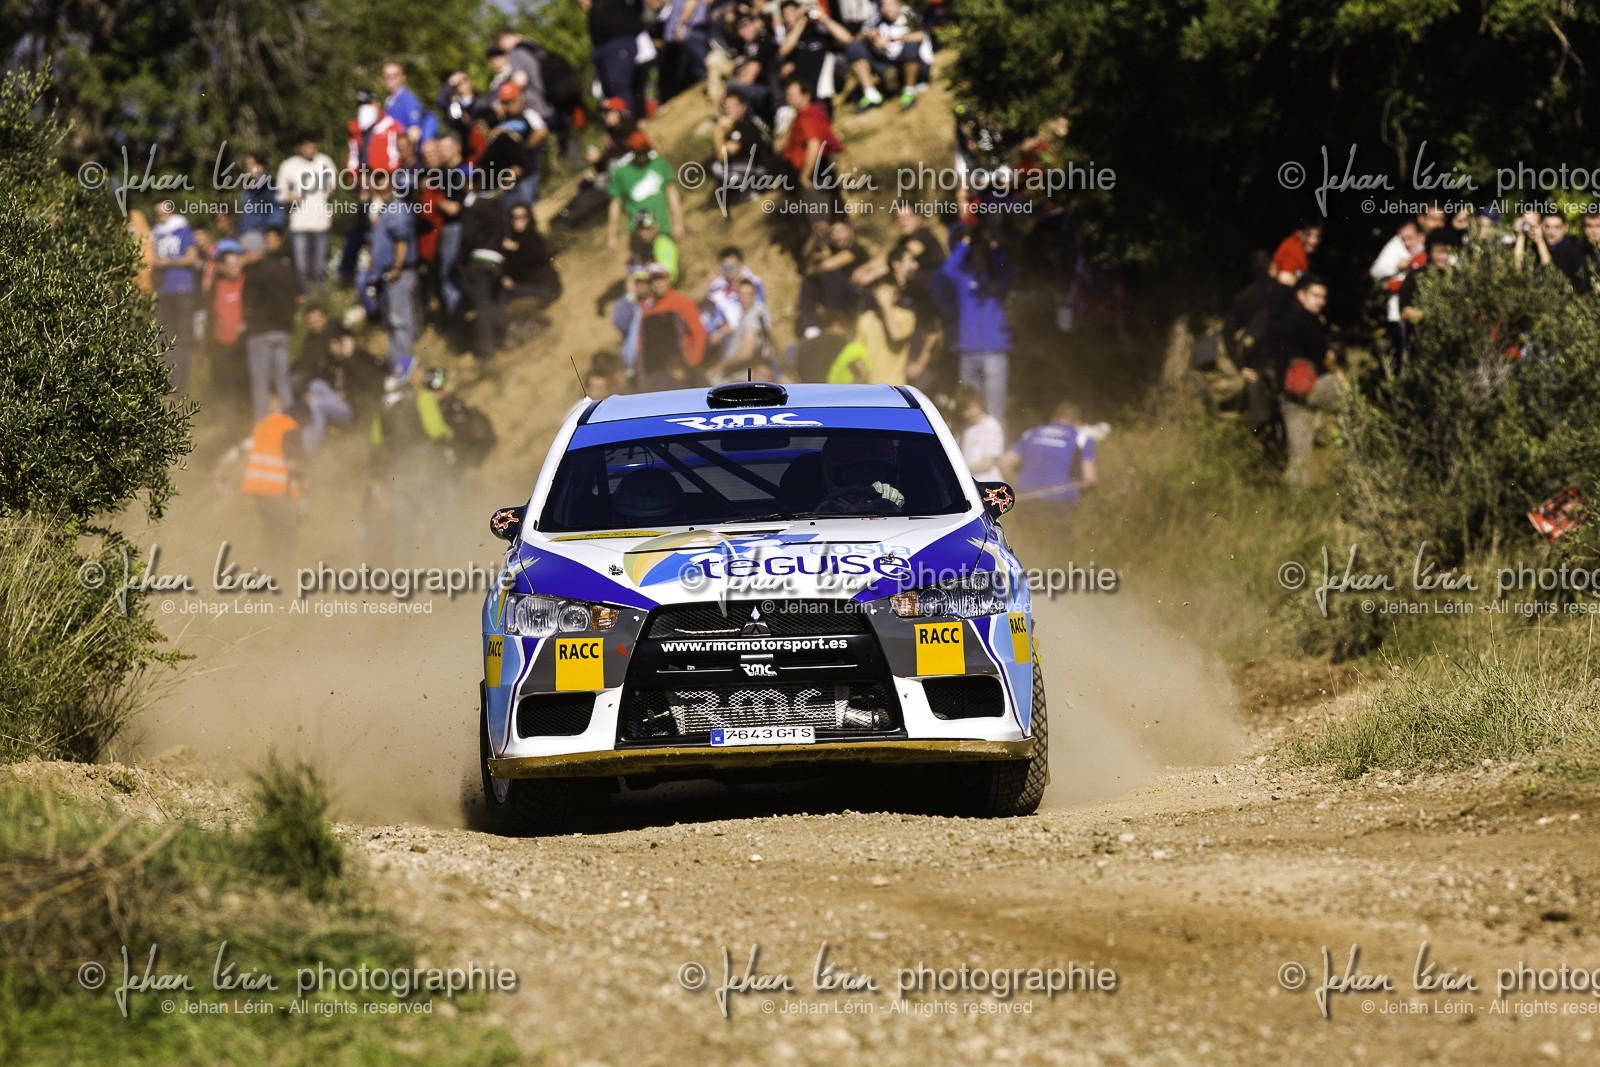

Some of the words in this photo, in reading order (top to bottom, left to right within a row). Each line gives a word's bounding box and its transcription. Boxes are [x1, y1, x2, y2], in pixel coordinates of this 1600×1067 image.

[809, 541, 911, 555] costa
[1009, 617, 1027, 634] RACC
[919, 628, 960, 644] RACC
[488, 641, 503, 657] RACC
[559, 643, 599, 660] RACC
[661, 637, 848, 653] www.rmcmotorsport.es
[726, 729, 773, 740] 7643
[776, 728, 811, 738] GTS
